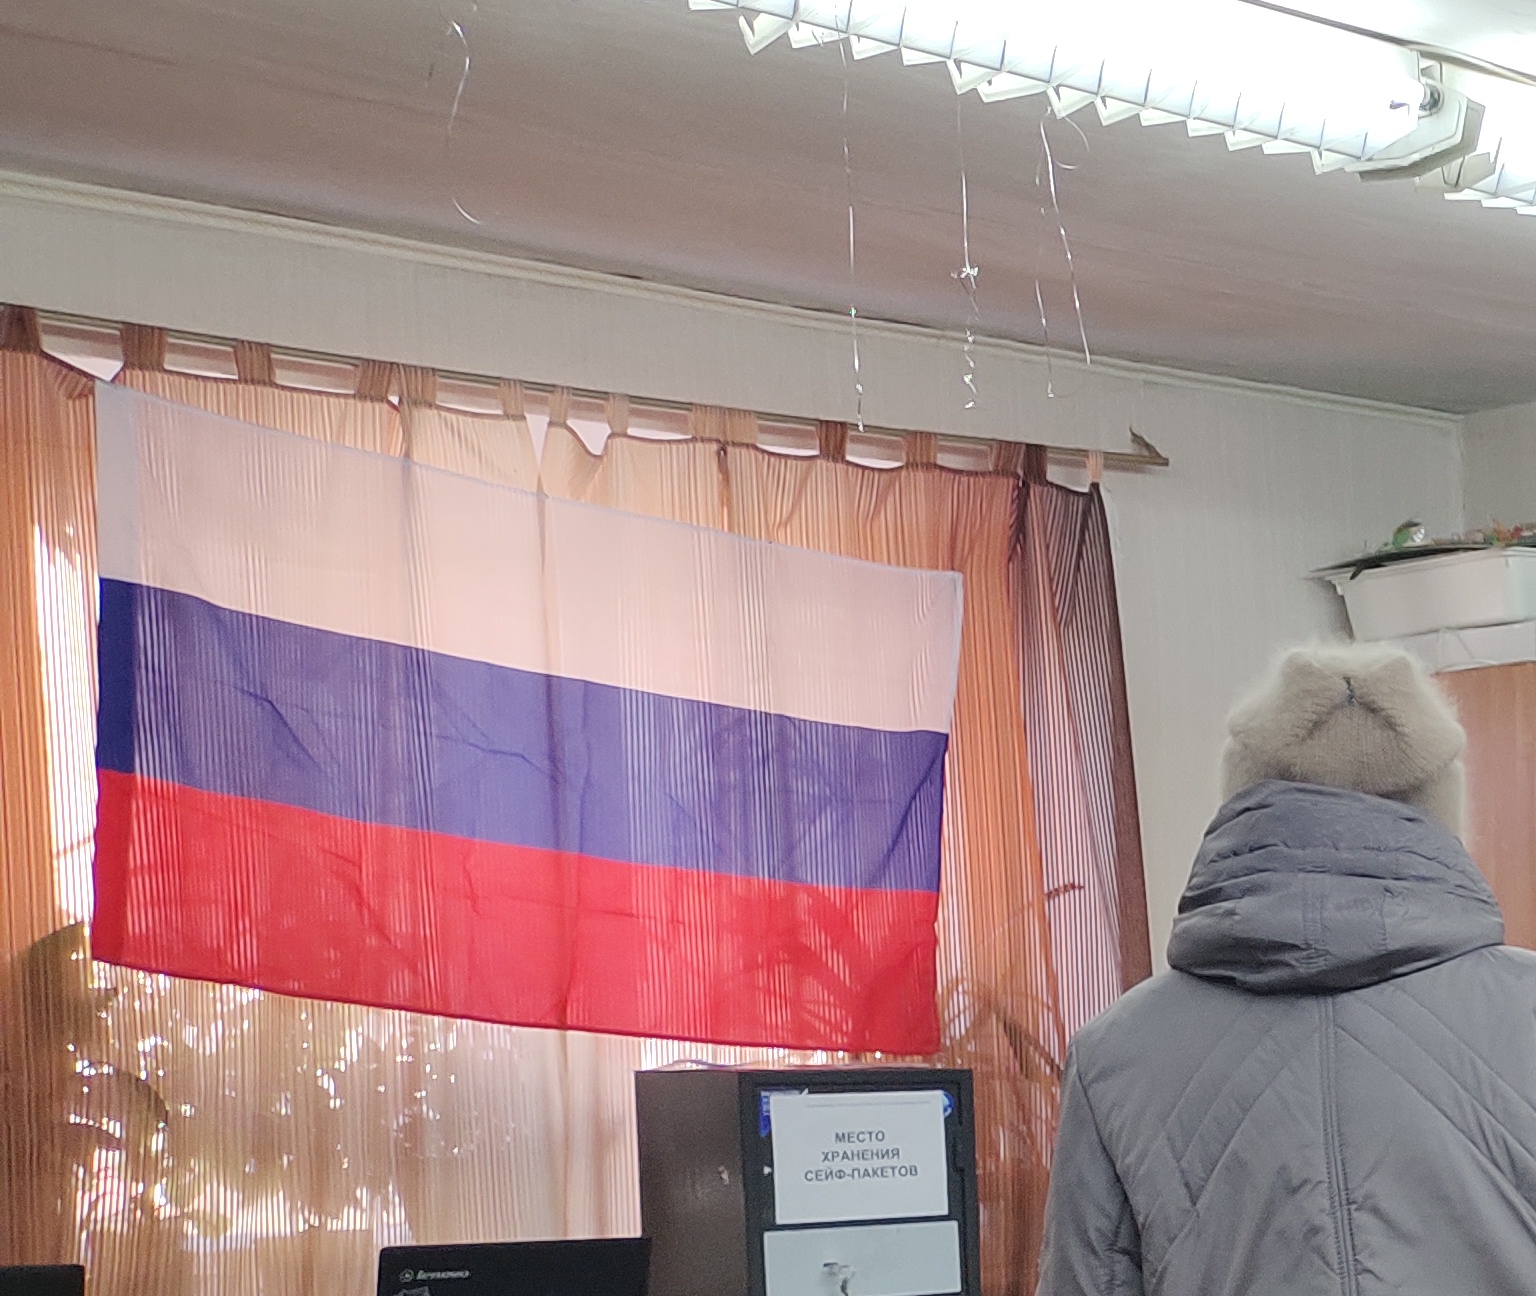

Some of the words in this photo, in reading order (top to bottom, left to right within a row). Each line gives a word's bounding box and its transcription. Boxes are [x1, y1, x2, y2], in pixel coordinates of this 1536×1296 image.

[834, 1130, 886, 1144] МЕСТО
[821, 1148, 901, 1163] ХРАНЕНИЯ
[803, 1165, 919, 1182] СЕЙФ-ПАКЕТОВ
